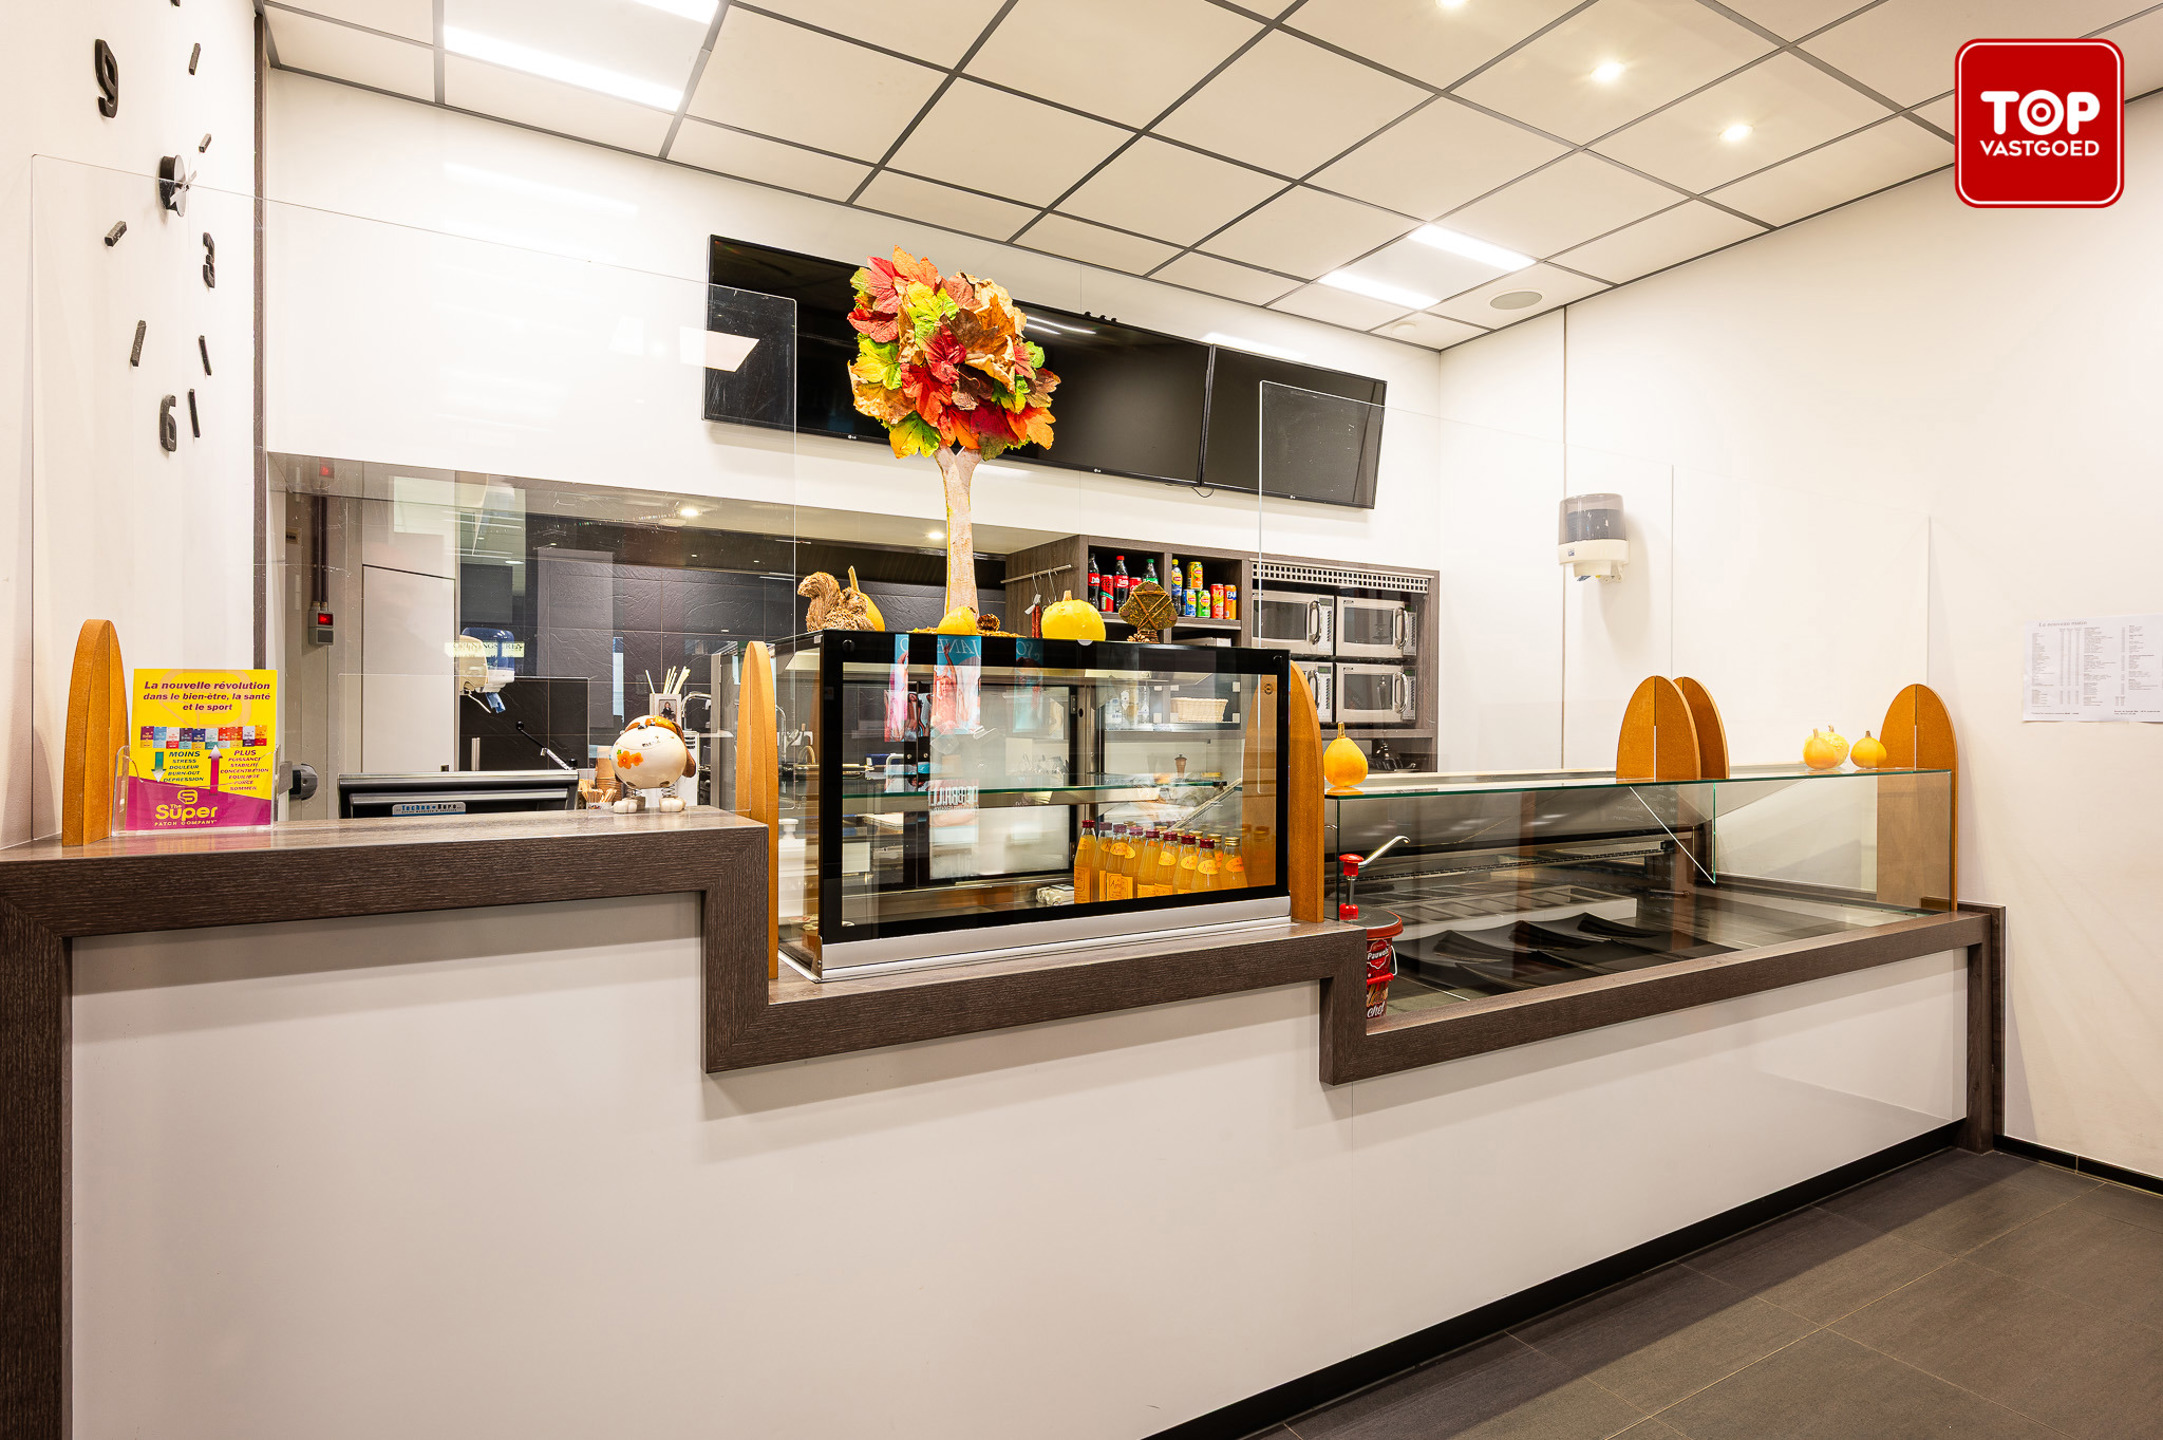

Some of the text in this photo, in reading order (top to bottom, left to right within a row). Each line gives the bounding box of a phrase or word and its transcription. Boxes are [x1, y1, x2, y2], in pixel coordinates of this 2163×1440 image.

[95, 39, 118, 118] 9
[160, 395, 176, 452] 6
[144, 681, 271, 690] La nouvelle révolution
[143, 692, 168, 700] dans
[170, 692, 180, 700] le
[231, 692, 242, 700] la
[244, 692, 271, 700] santé
[182, 703, 233, 712] et le sport
[168, 750, 201, 758] MOINS
[155, 804, 218, 821] Super
